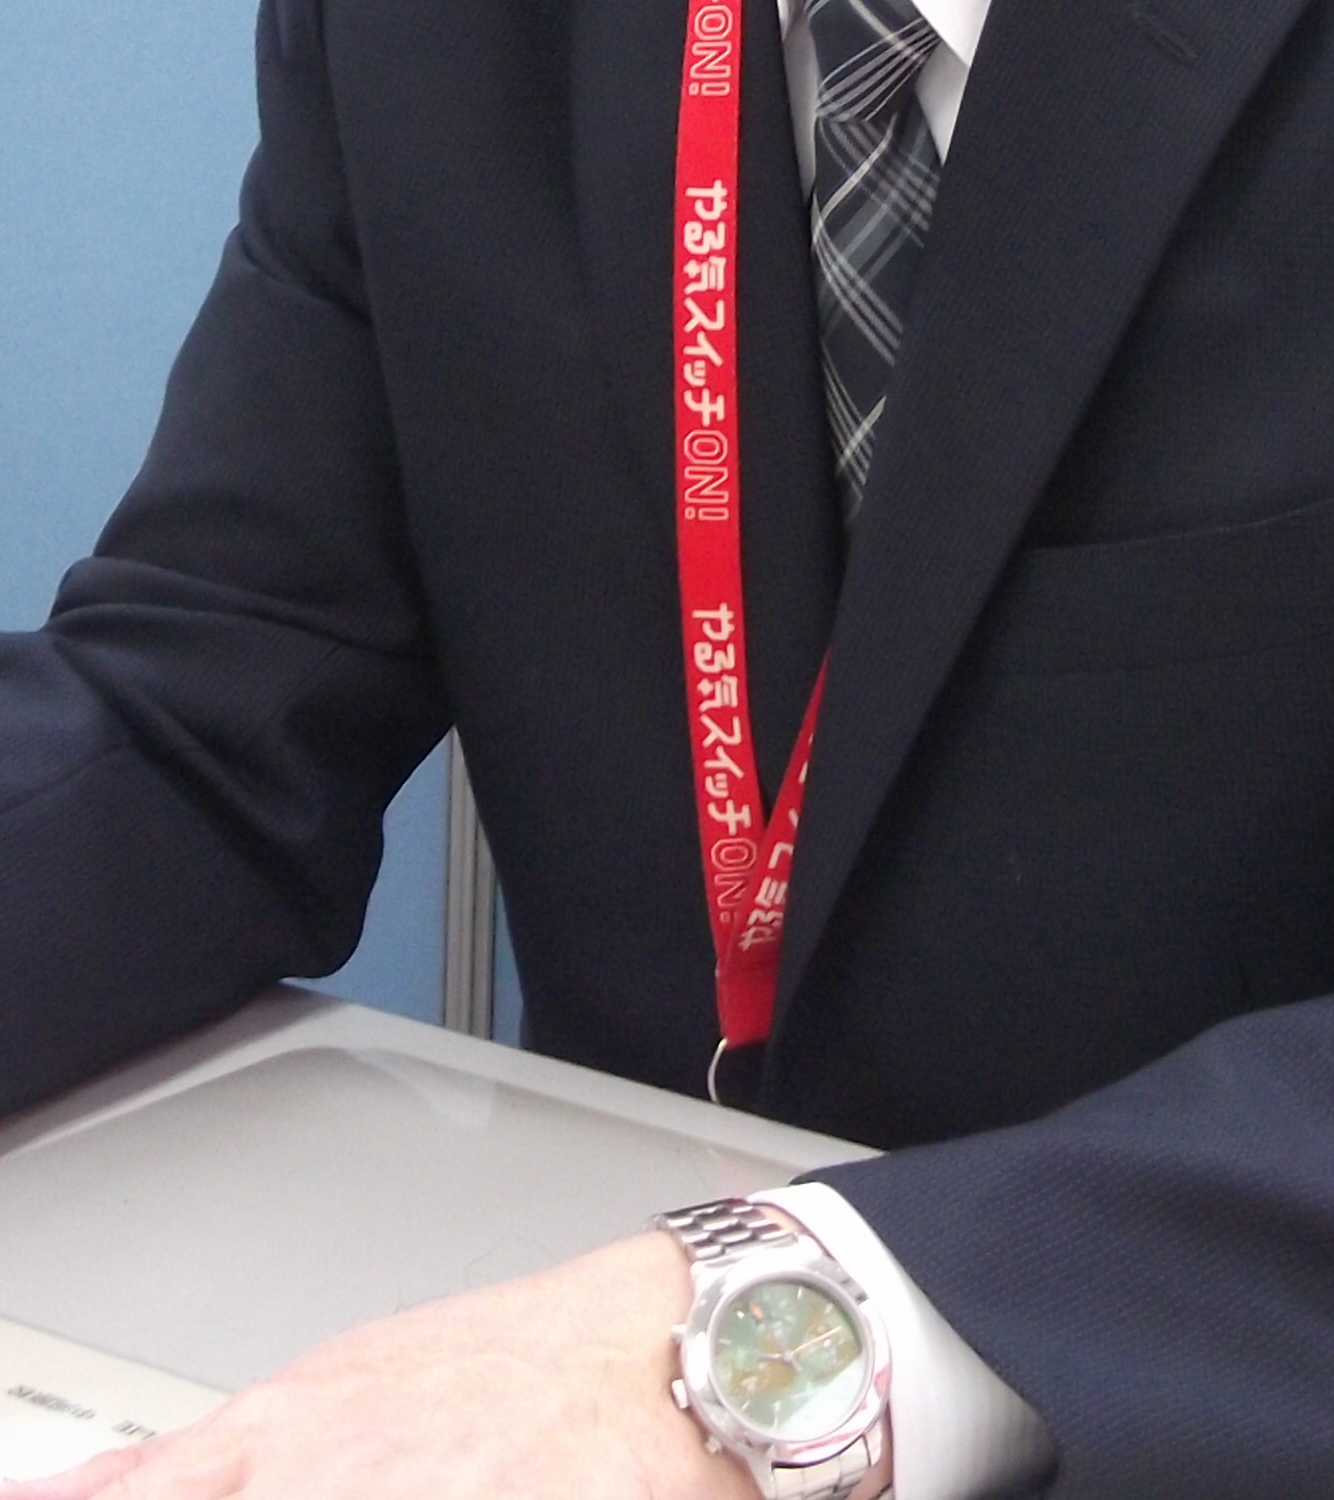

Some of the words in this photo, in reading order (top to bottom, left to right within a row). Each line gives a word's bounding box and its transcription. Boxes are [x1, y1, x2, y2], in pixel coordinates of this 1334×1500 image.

[683, 179, 729, 521] やる気スイッチON!
